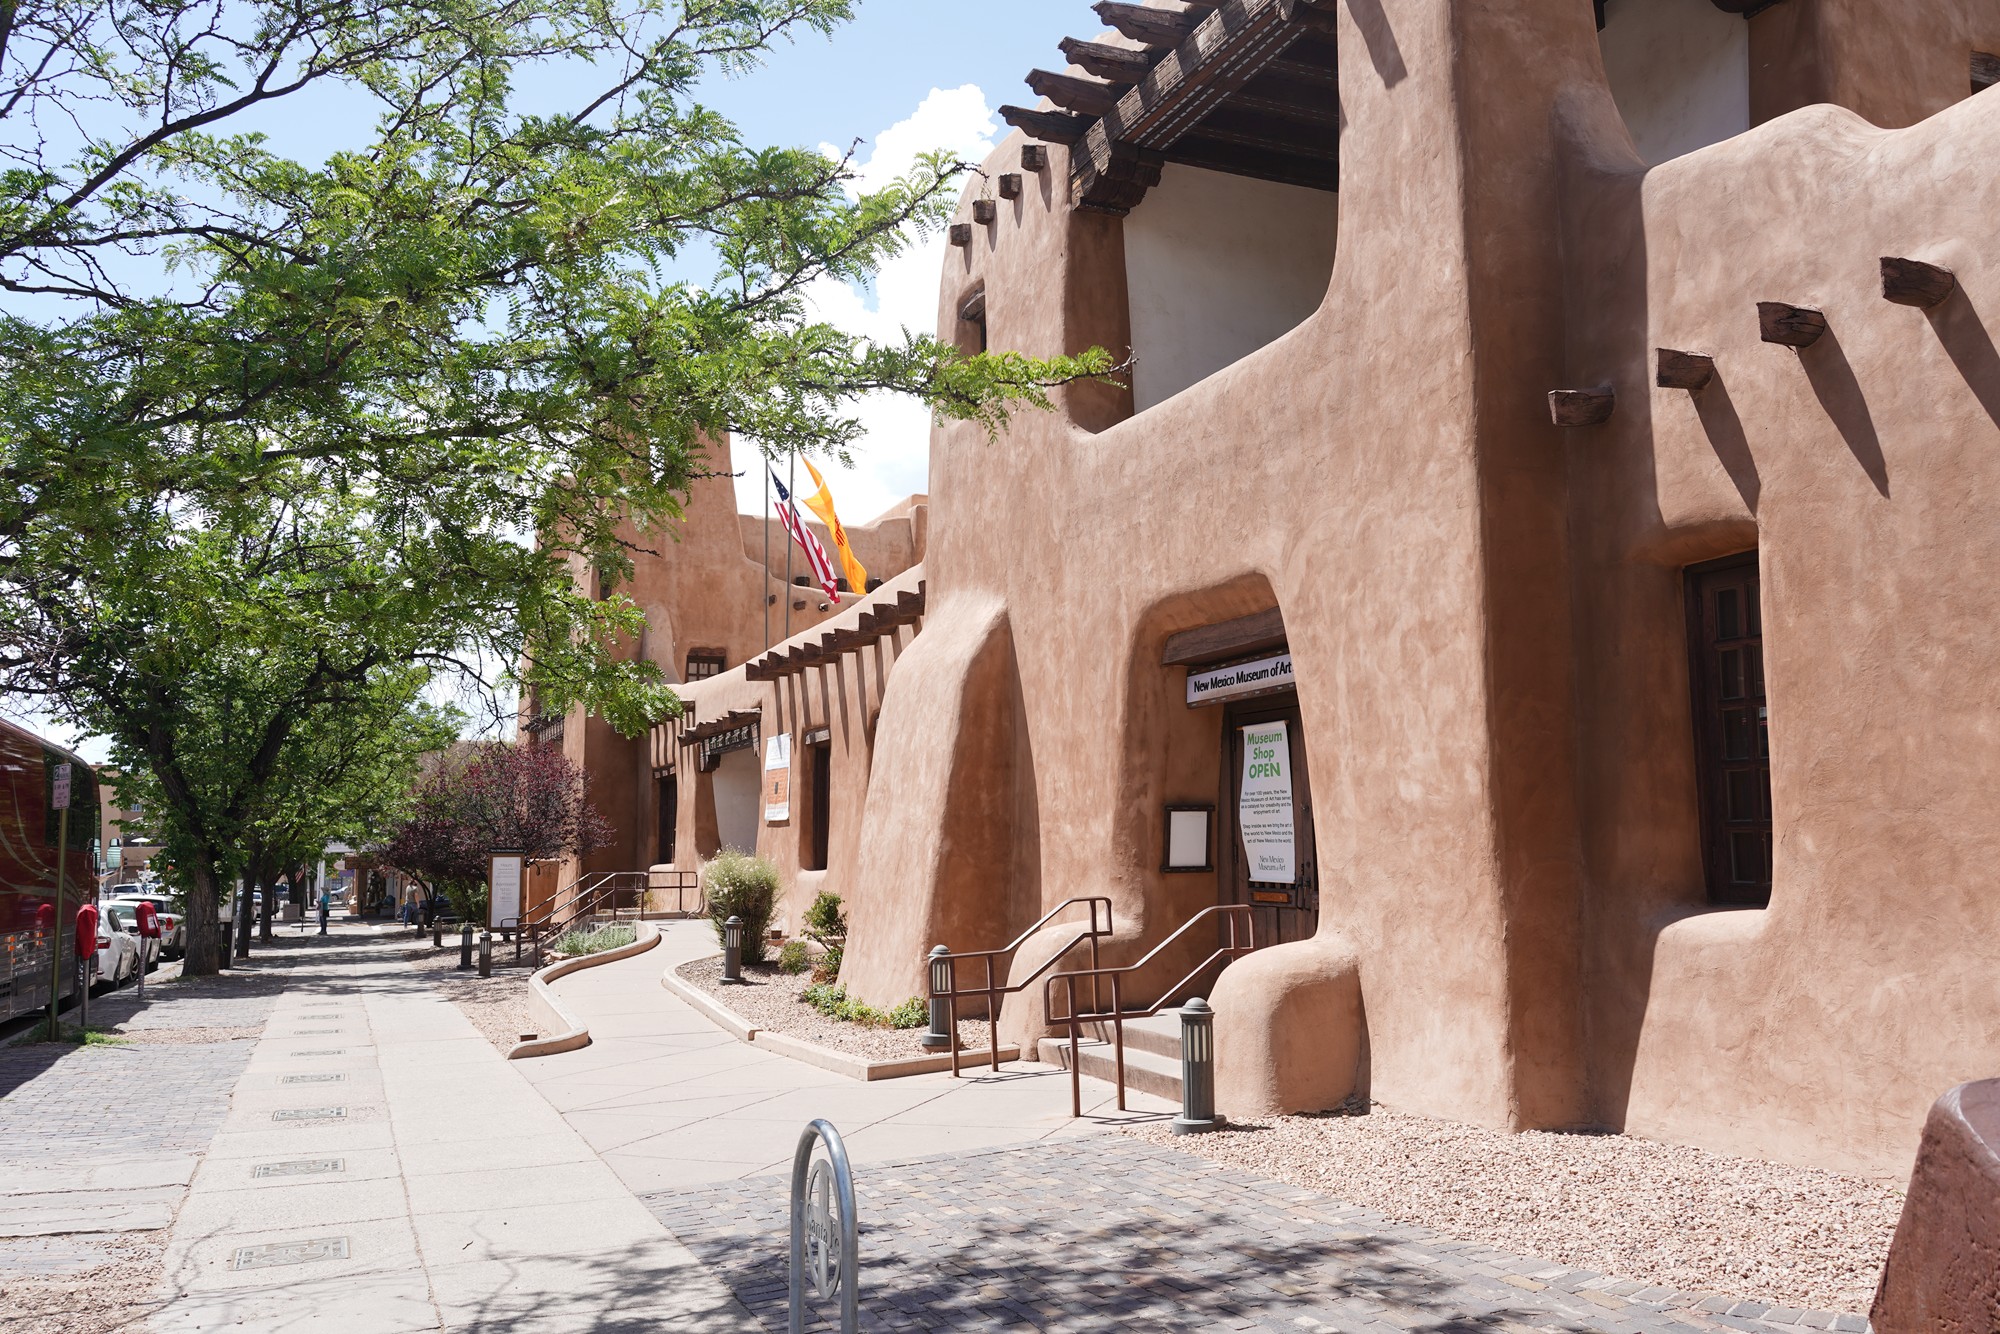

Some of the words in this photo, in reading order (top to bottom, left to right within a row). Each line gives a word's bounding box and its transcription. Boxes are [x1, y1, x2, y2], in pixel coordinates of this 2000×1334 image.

[1194, 680, 1209, 692] New
[1210, 675, 1234, 689] Mexico
[1236, 670, 1269, 684] Museum
[1270, 662, 1280, 676] of
[1279, 662, 1292, 675] Art
[1247, 732, 1282, 745] Museum
[1253, 746, 1274, 762] Shop
[1249, 762, 1280, 779] OPEN
[807, 1203, 827, 1244] Santa
[830, 1220, 840, 1254] Fe
